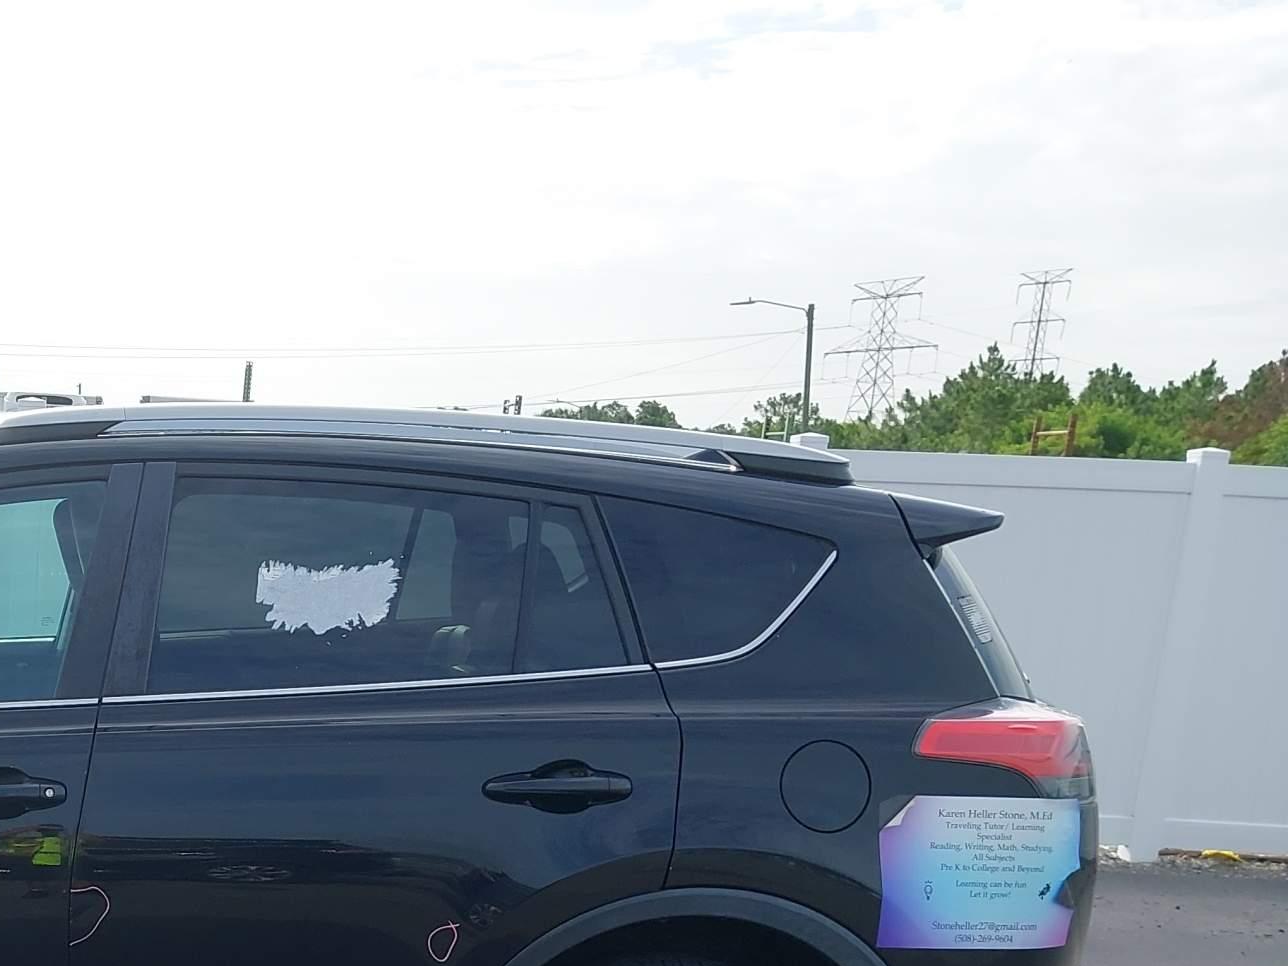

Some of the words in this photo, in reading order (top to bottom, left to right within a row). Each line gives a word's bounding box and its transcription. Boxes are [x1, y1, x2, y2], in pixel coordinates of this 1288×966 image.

[938, 809, 966, 818] Karen
[968, 810, 997, 819] Heller
[999, 810, 1028, 820] Stone,
[1030, 811, 1053, 820] M.Ed
[945, 821, 982, 831] Traveling
[1011, 824, 1045, 832] Learning
[976, 833, 1013, 842] Specialist
[930, 842, 962, 852] Reading,
[972, 853, 984, 861] All
[985, 854, 1016, 862] Subjects
[940, 863, 953, 871] Pre
[971, 864, 1000, 873] College
[1017, 866, 1045, 874] Beyond
[955, 880, 988, 889] Learning
[1014, 881, 1027, 889] fun
